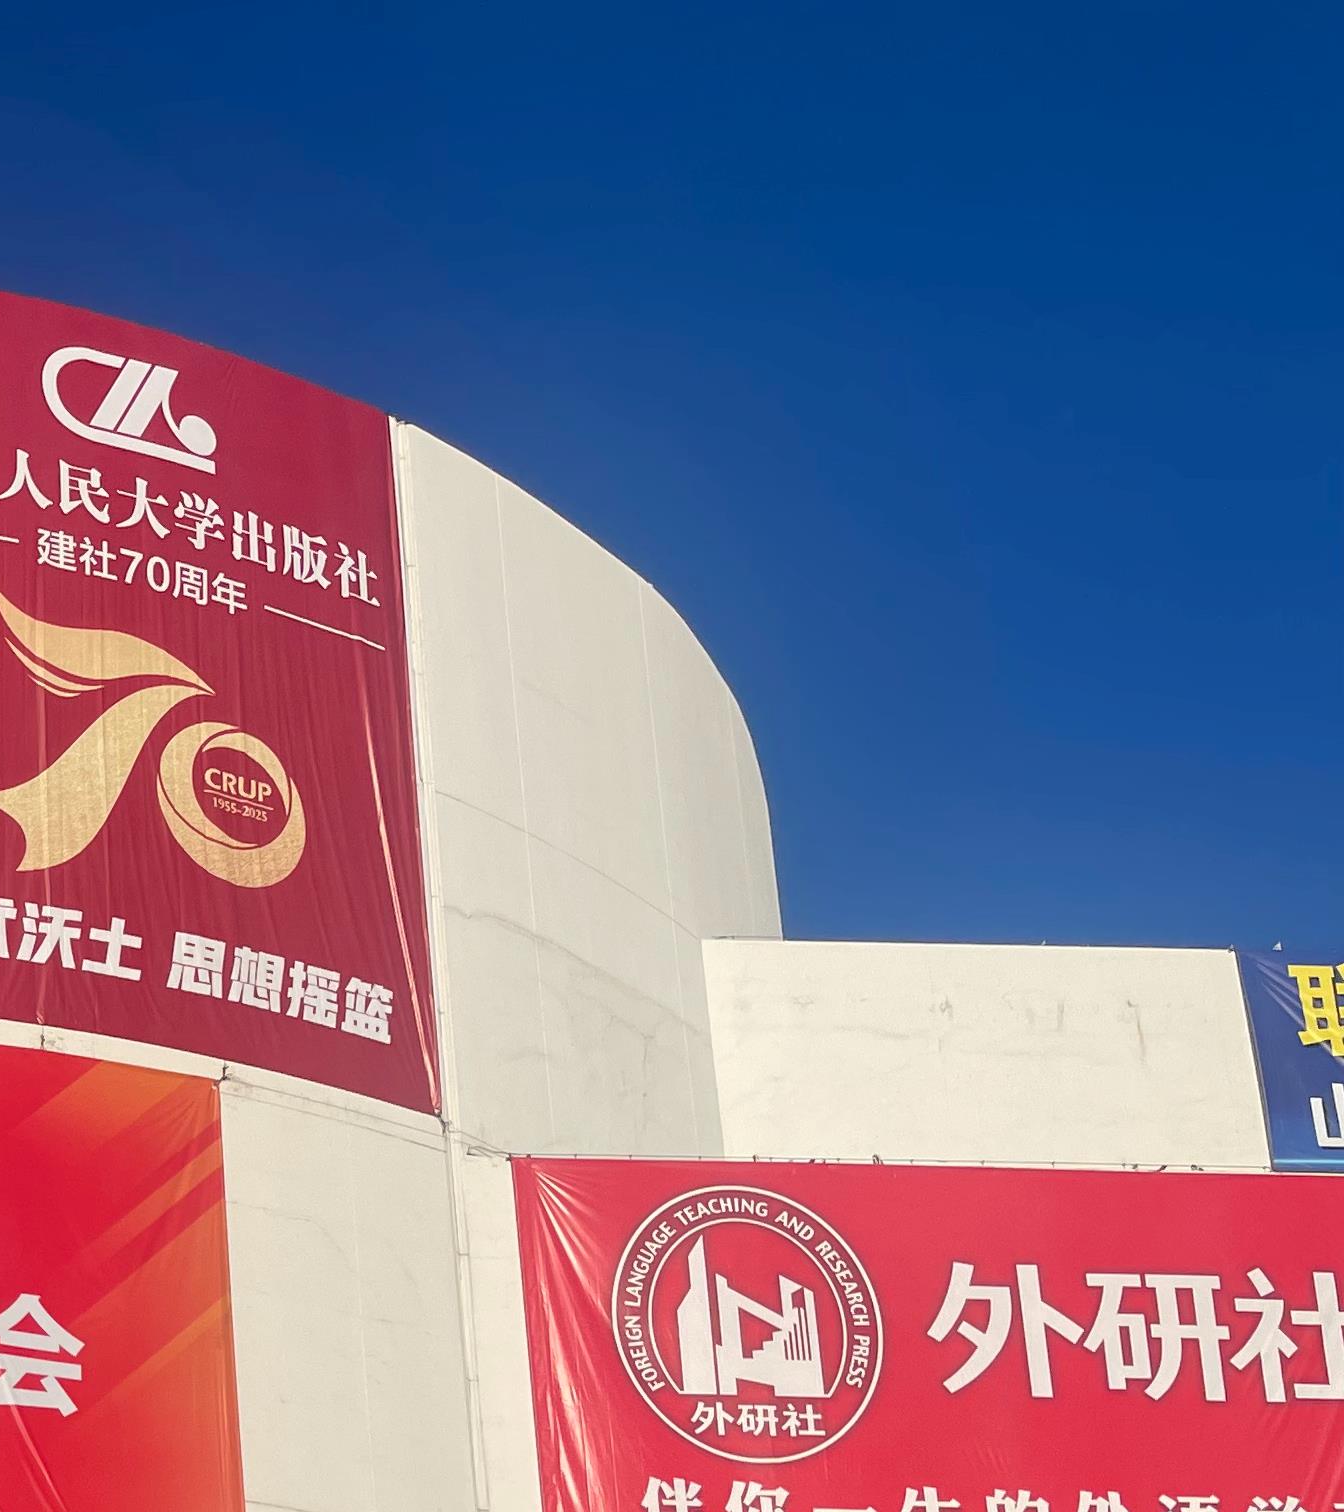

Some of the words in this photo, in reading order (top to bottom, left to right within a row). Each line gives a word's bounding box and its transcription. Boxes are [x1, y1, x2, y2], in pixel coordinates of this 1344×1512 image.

[36, 528, 248, 615] 建社70周年
[204, 767, 272, 802] CRUP
[166, 931, 394, 1046] 思想摇篮
[674, 1197, 769, 1227] TEACHING
[775, 1211, 815, 1242] AND
[624, 1221, 677, 1307] LANGUAGE
[815, 1241, 870, 1327] RESEARCH
[624, 1314, 665, 1392] FOREIGN
[846, 1334, 871, 1388] PRESS
[928, 1260, 1344, 1404] 外研社
[691, 1402, 826, 1437] 外研社
